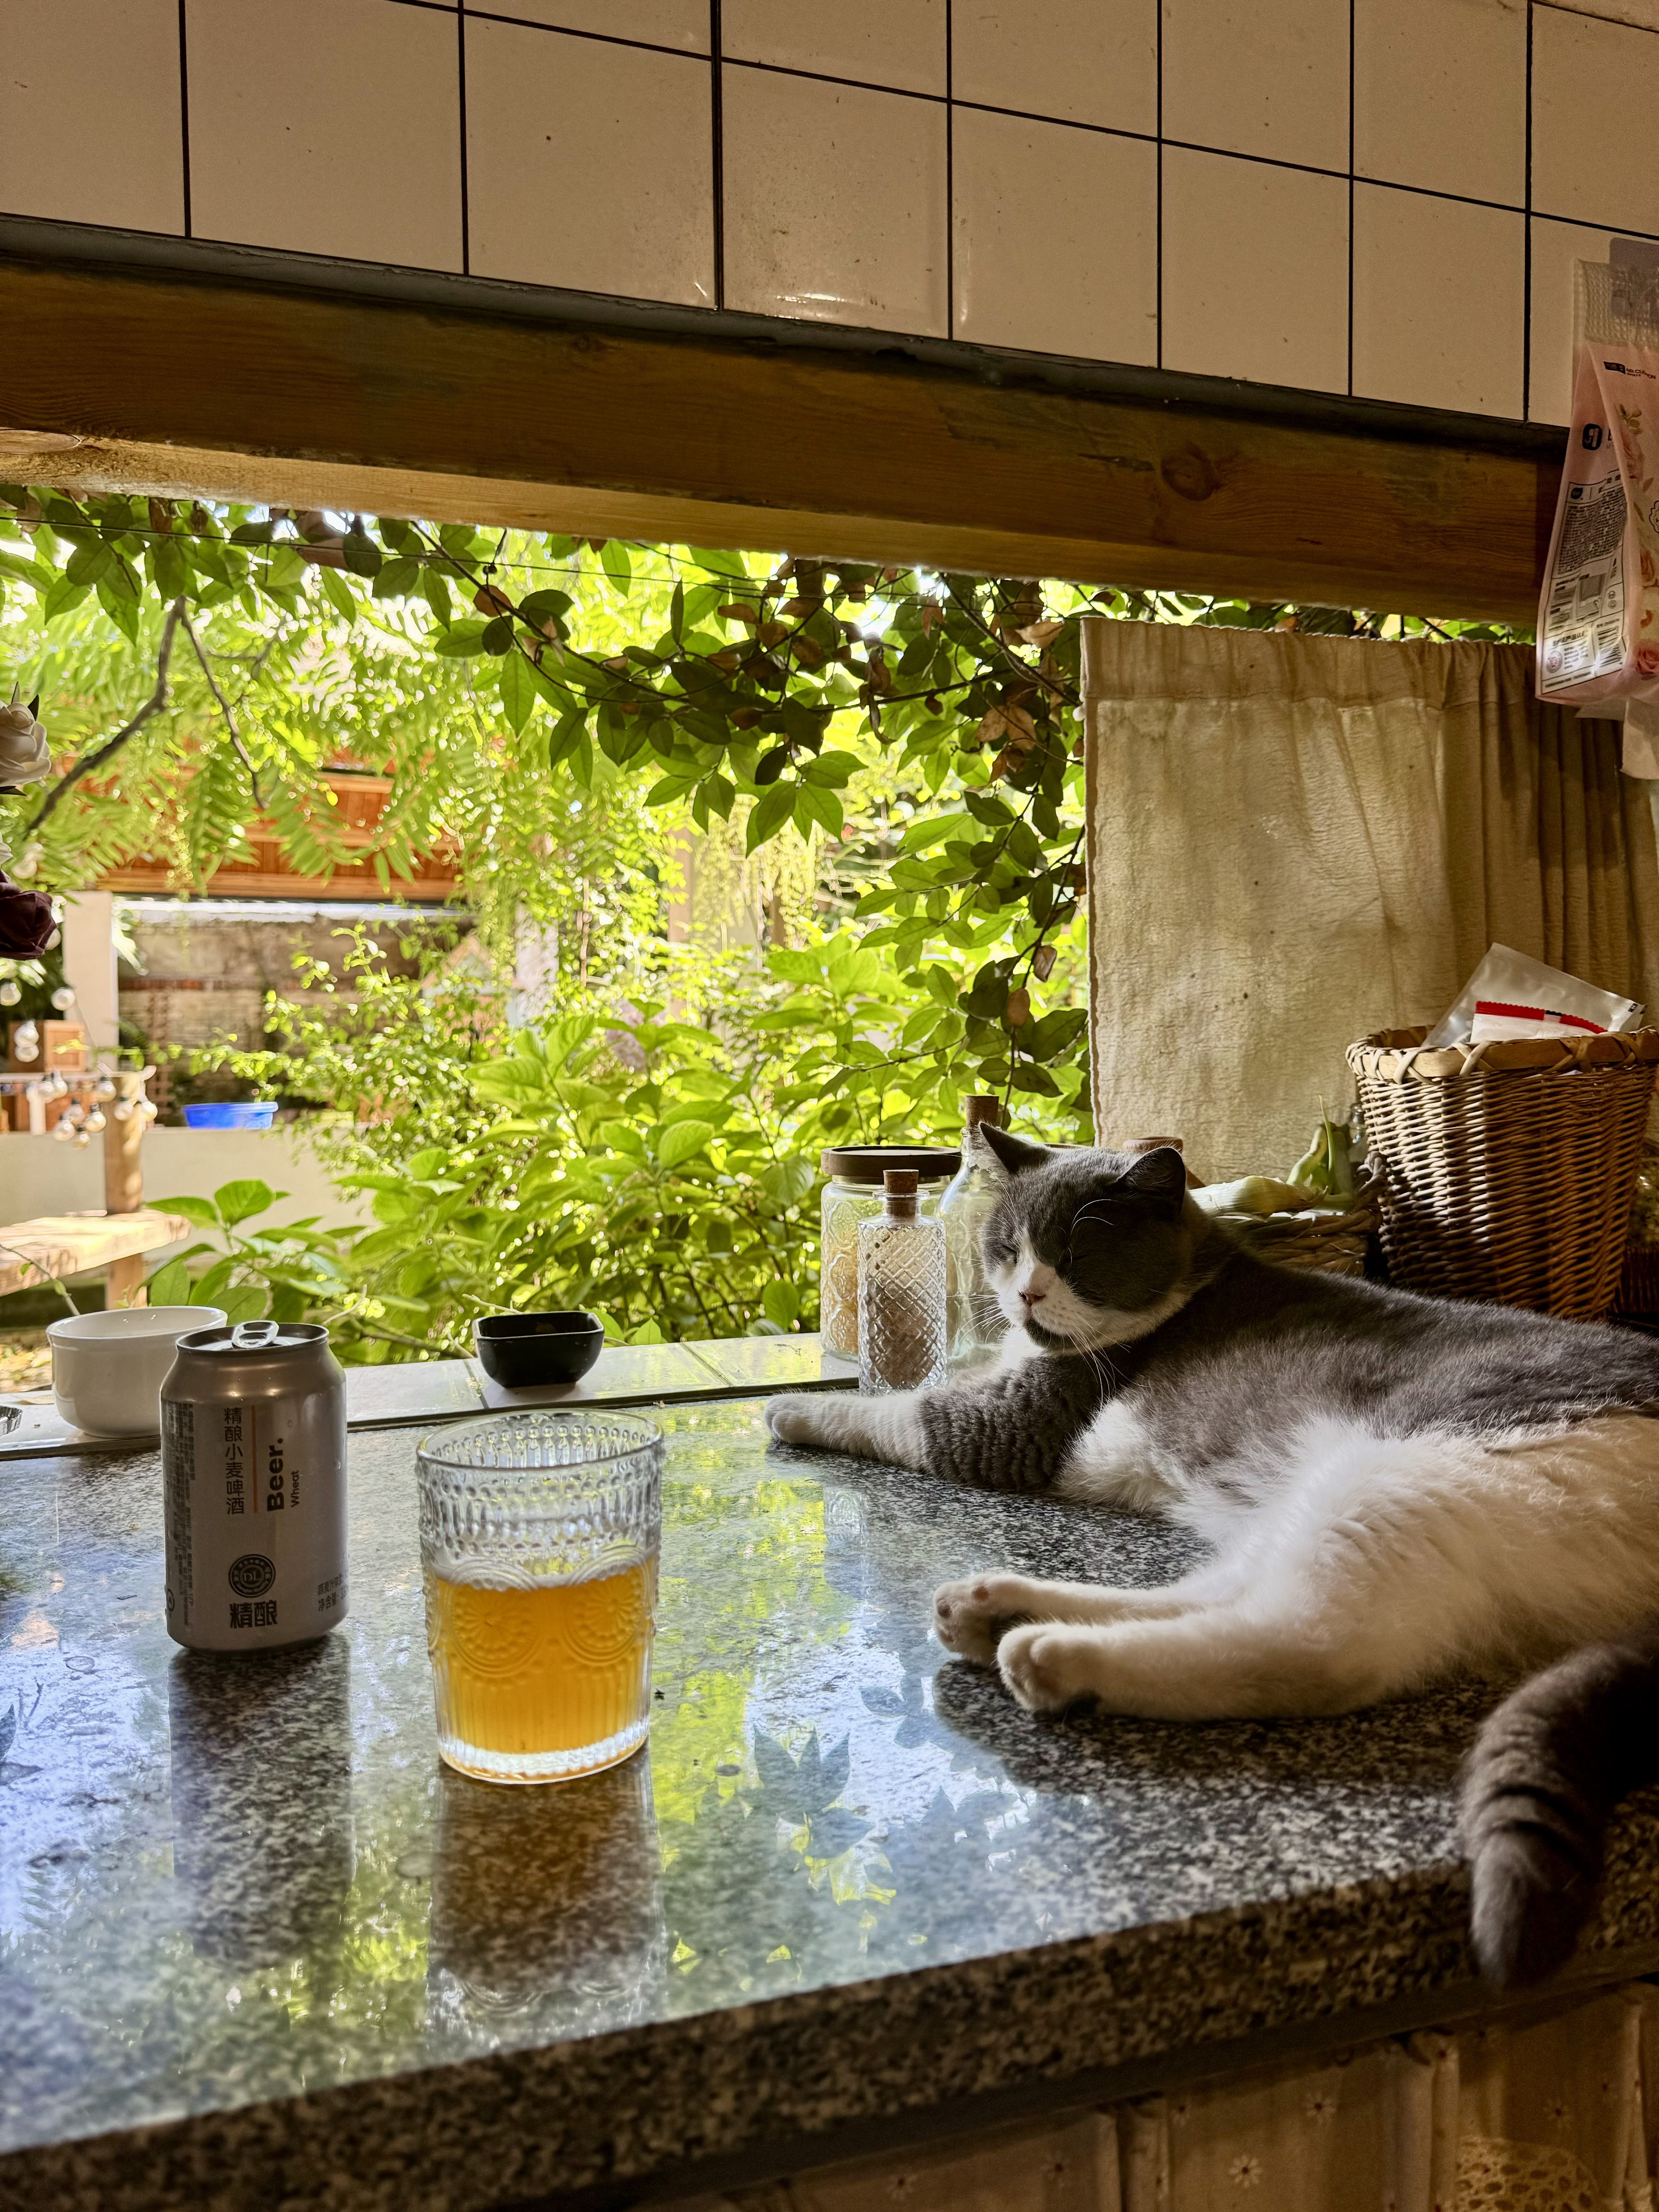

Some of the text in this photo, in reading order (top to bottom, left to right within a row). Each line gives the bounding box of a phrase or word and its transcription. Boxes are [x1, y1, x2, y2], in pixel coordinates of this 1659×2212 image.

[224, 1407, 244, 1515] 精酿小麦啤酒
[267, 1438, 285, 1511] Beer.
[291, 1470, 300, 1508] Wheat
[230, 1600, 278, 1628] 精酿
